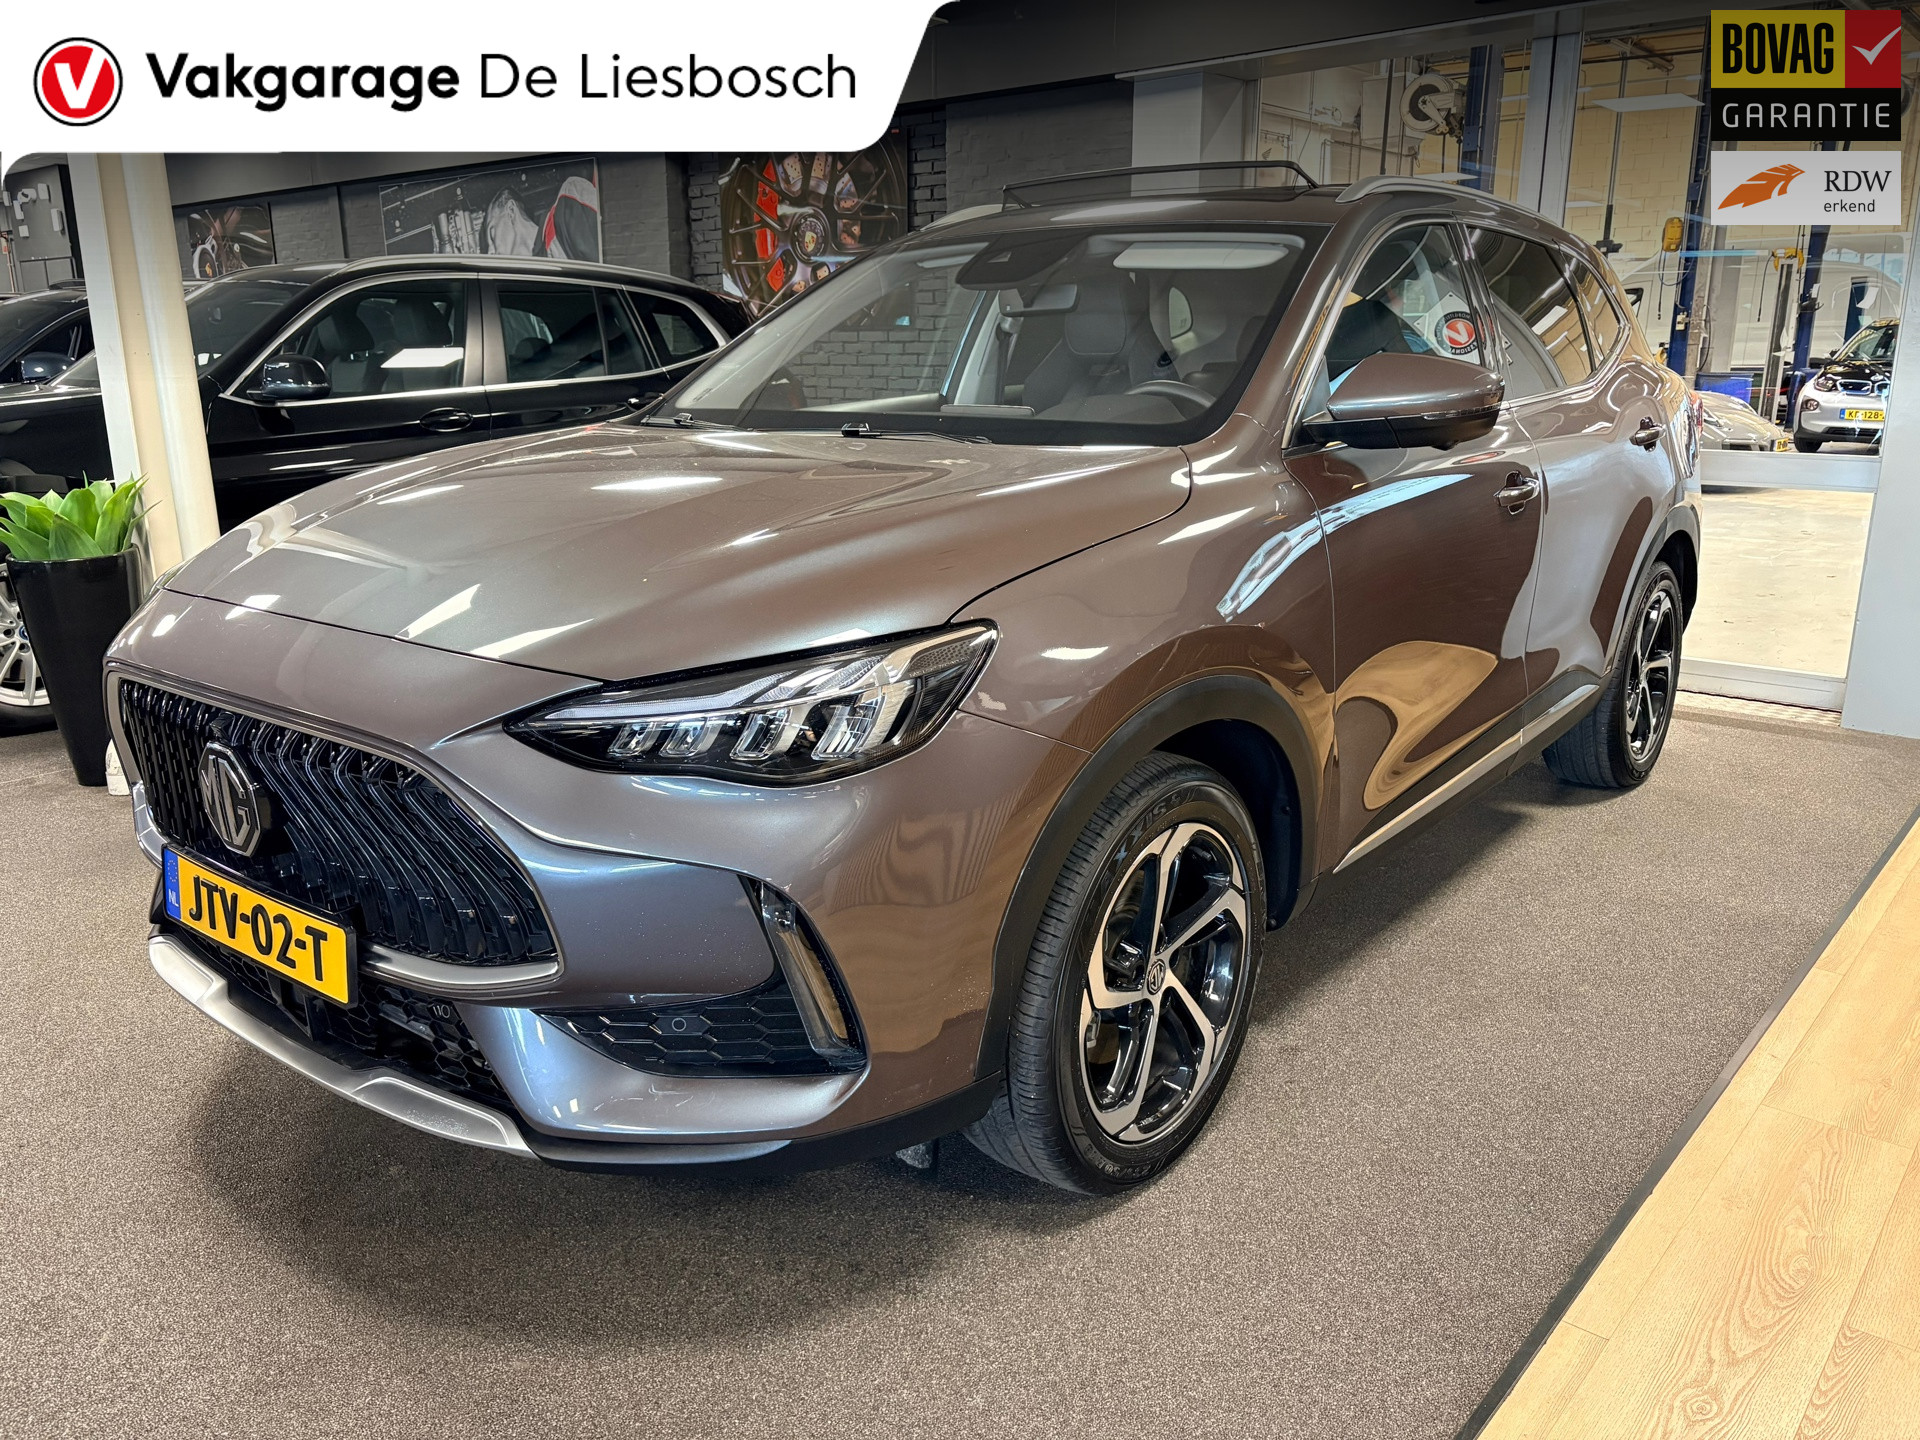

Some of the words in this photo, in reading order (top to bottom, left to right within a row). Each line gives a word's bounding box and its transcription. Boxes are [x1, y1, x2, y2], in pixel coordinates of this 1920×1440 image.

[201, 755, 249, 847] MG
[168, 888, 179, 907] NL
[189, 874, 328, 982] JTV-02-T
